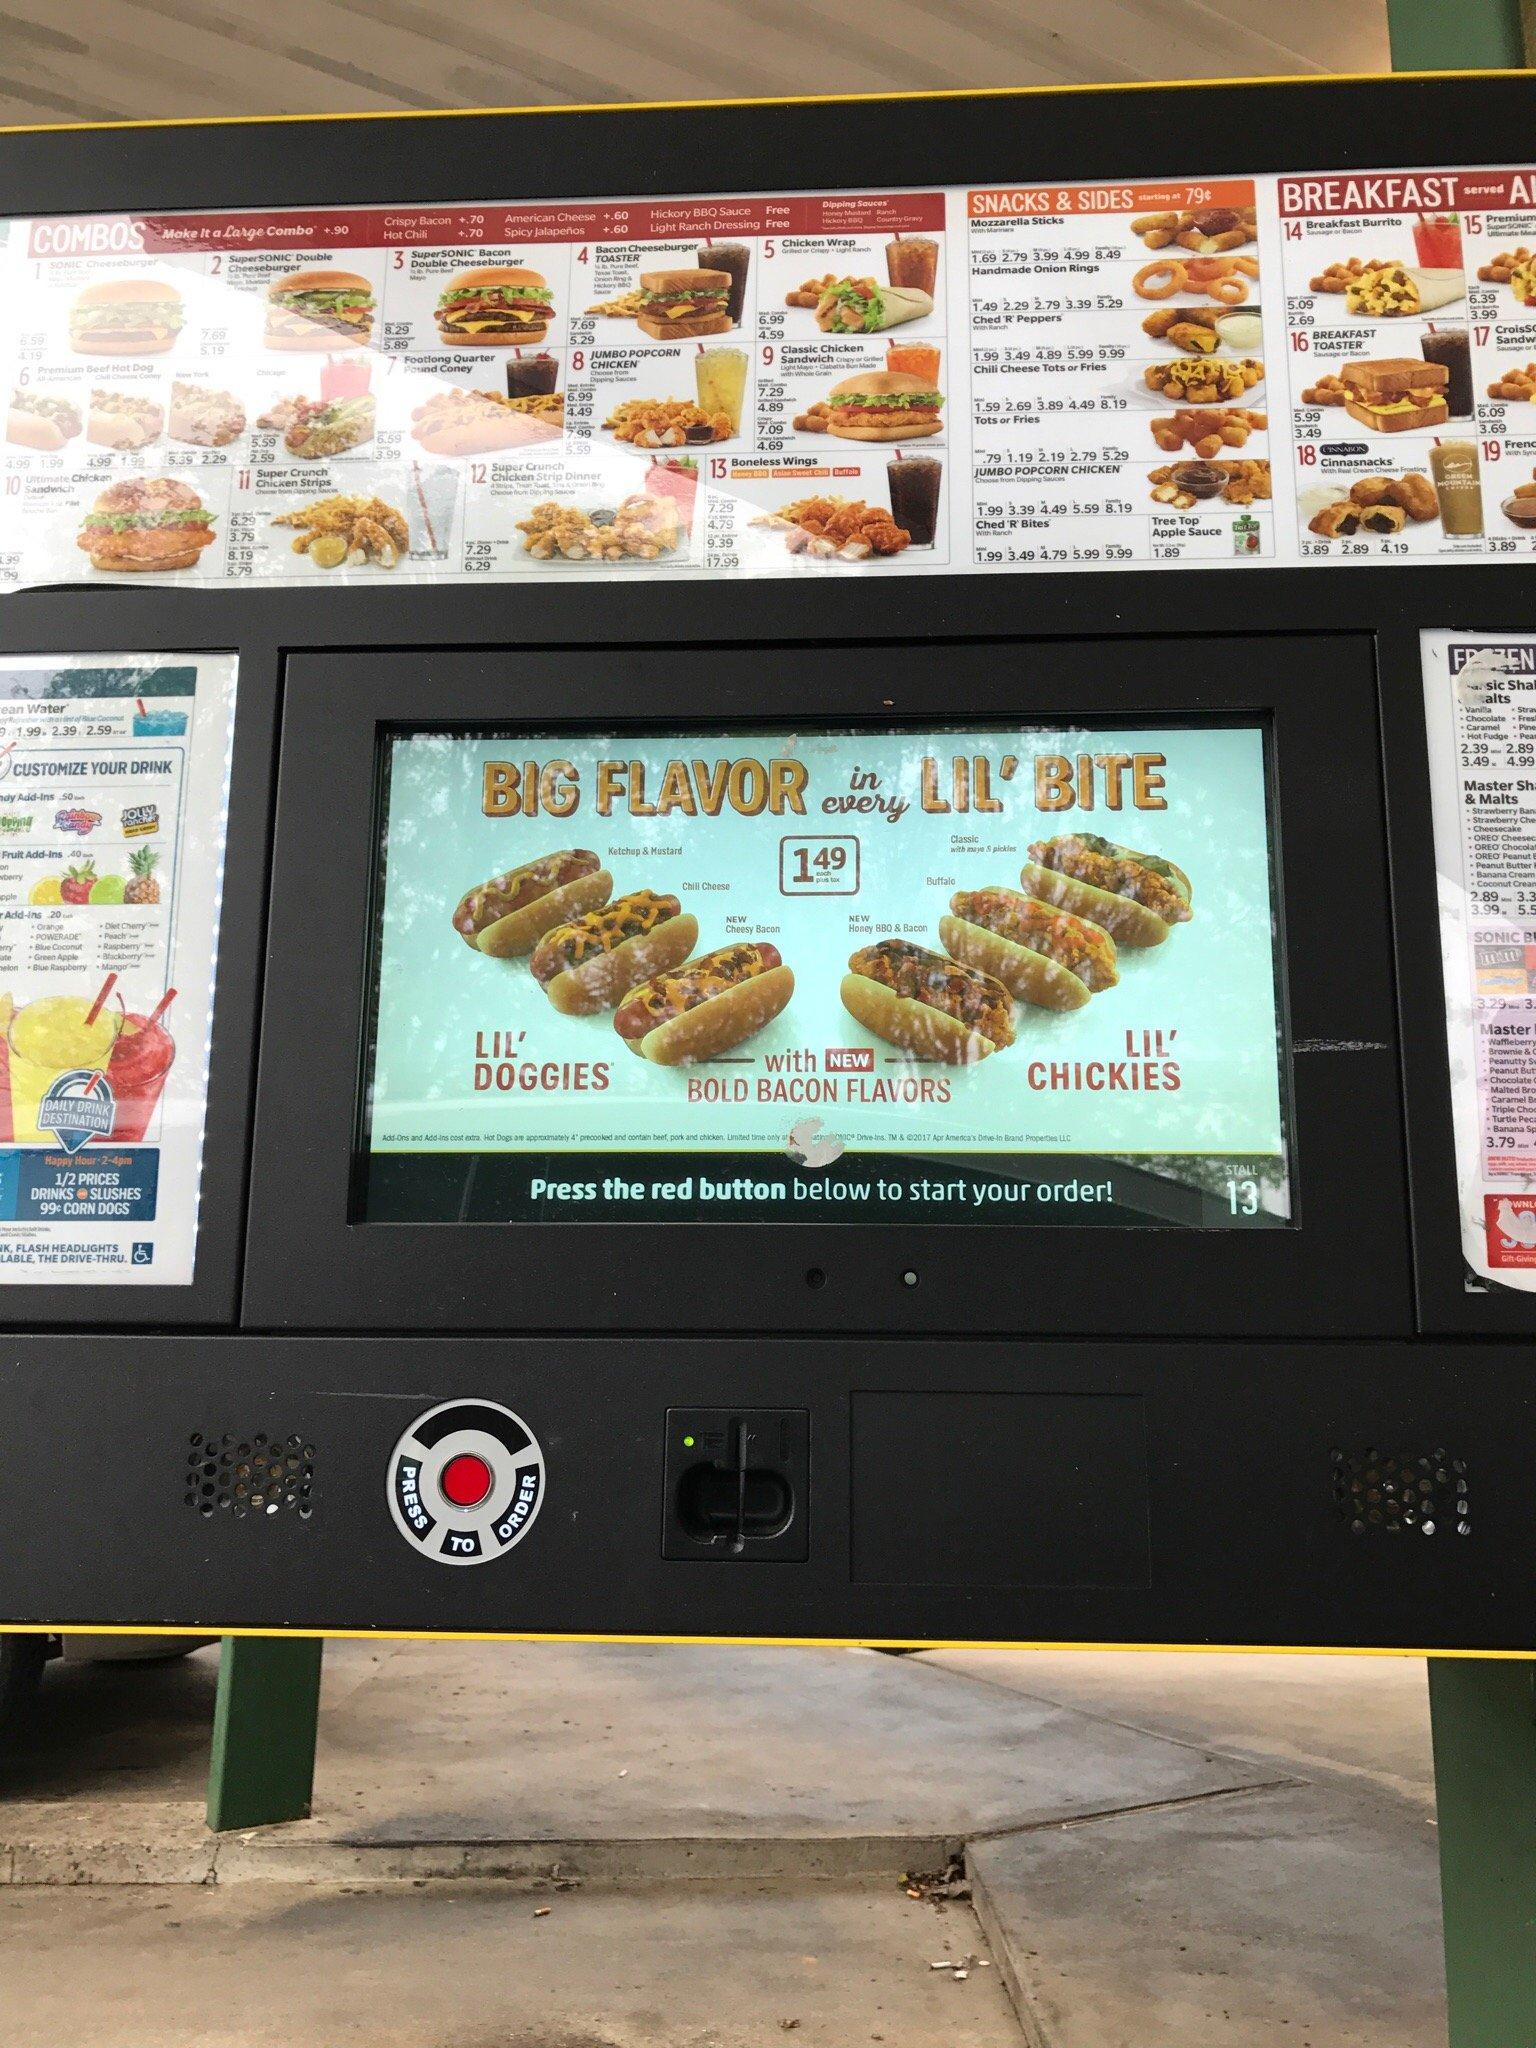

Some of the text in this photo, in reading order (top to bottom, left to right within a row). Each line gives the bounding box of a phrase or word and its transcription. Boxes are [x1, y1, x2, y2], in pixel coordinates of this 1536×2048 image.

[1284, 177, 1504, 211] BREAKFAST served
[823, 201, 856, 209] Dipping
[973, 193, 1049, 213] SNACKS
[1057, 192, 1071, 211] &
[1079, 190, 1133, 210] SIDES
[1139, 194, 1169, 202] starting
[1186, 188, 1212, 204] 79¢
[505, 212, 628, 223] American Cheese +.60
[650, 206, 790, 221] Hickory BBQ Sauce Free
[385, 216, 484, 226] Crispy Bacon +.70
[650, 220, 790, 234] Light Ranch Dressing Free
[971, 217, 1064, 227] Mozzarella Sticks
[163, 229, 197, 240] Make
[200, 227, 211, 237] It
[223, 225, 264, 241] Large
[266, 225, 313, 236] Combo
[324, 225, 349, 235] +.90
[384, 229, 483, 239] Hot Chili +.70
[504, 225, 628, 238] Spicy Jalapeños +.60
[1284, 218, 1402, 240] 14 Breakfast Burrito
[34, 222, 146, 254] COMBOS
[596, 243, 697, 253] Bacon Cheeseburger
[765, 239, 855, 258] 5 Chicken Wrap
[229, 253, 333, 264] SuperSONIC Double
[394, 251, 404, 269] 3
[412, 250, 474, 259] SuperSONIC
[411, 258, 524, 268] Double Cheeseburger
[596, 254, 639, 262] TOASTER
[972, 251, 1121, 263] 1.69 2.79 3.99 4.99 8.49
[229, 263, 301, 273] Cheeseburger
[972, 264, 1099, 275] Handmade Onion Rings
[573, 349, 680, 370] 8 JUMBO POPCORN
[763, 345, 863, 365] 9 Classic Chicken
[781, 354, 833, 364] Sandwich
[591, 360, 637, 369] CHICKEN
[974, 416, 997, 424] Tots
[1014, 415, 1040, 423] Fries
[1297, 445, 1392, 466] 18 Cinnasnacks
[710, 457, 817, 478] 13 Boneless Wings
[1152, 516, 1199, 526] Tree Top
[1152, 527, 1221, 538] Apple Sauce
[14, 761, 172, 776] CUSTOMIZE YOUR DRINK
[482, 753, 1168, 824] BIG FLAVOR in every LIL' BITE
[1465, 780, 1513, 791] Master
[1465, 794, 1518, 804] & Malts
[951, 835, 979, 844] Classic
[608, 847, 682, 857] Ketchup & Mustard
[682, 882, 730, 890] Chili Cheese
[927, 877, 956, 885] Buffalo
[726, 925, 780, 934] Cheesy Bacon
[849, 924, 927, 935] Honey BBQ & Bacon
[476, 1032, 526, 1059] LIL'
[1126, 1030, 1177, 1058] LIL'
[764, 1048, 869, 1073] with NEW
[474, 1063, 611, 1090] DOGGIES
[1028, 1062, 1181, 1091] CHICKIES
[688, 1078, 951, 1104] BOLD BACON FLAVORS
[45, 1100, 110, 1117] DAILY DRINK
[43, 1113, 108, 1129] DESTINATION
[1226, 1165, 1257, 1176] STALL
[55, 1173, 120, 1185] 1/2 PRICES
[31, 1188, 73, 1200] DRINKS
[90, 1188, 141, 1200] SLUSHES
[531, 1177, 1113, 1208] Press the red button below to start your order!
[1227, 1181, 1258, 1215] 13
[41, 1203, 129, 1214] 99¢ CORN DOGS
[16, 1244, 118, 1253] FLASH HEADLIGHTS
[39, 1255, 127, 1263] THE DRIVE-THRU.
[402, 1466, 536, 1552] PRESS TO ORDER
